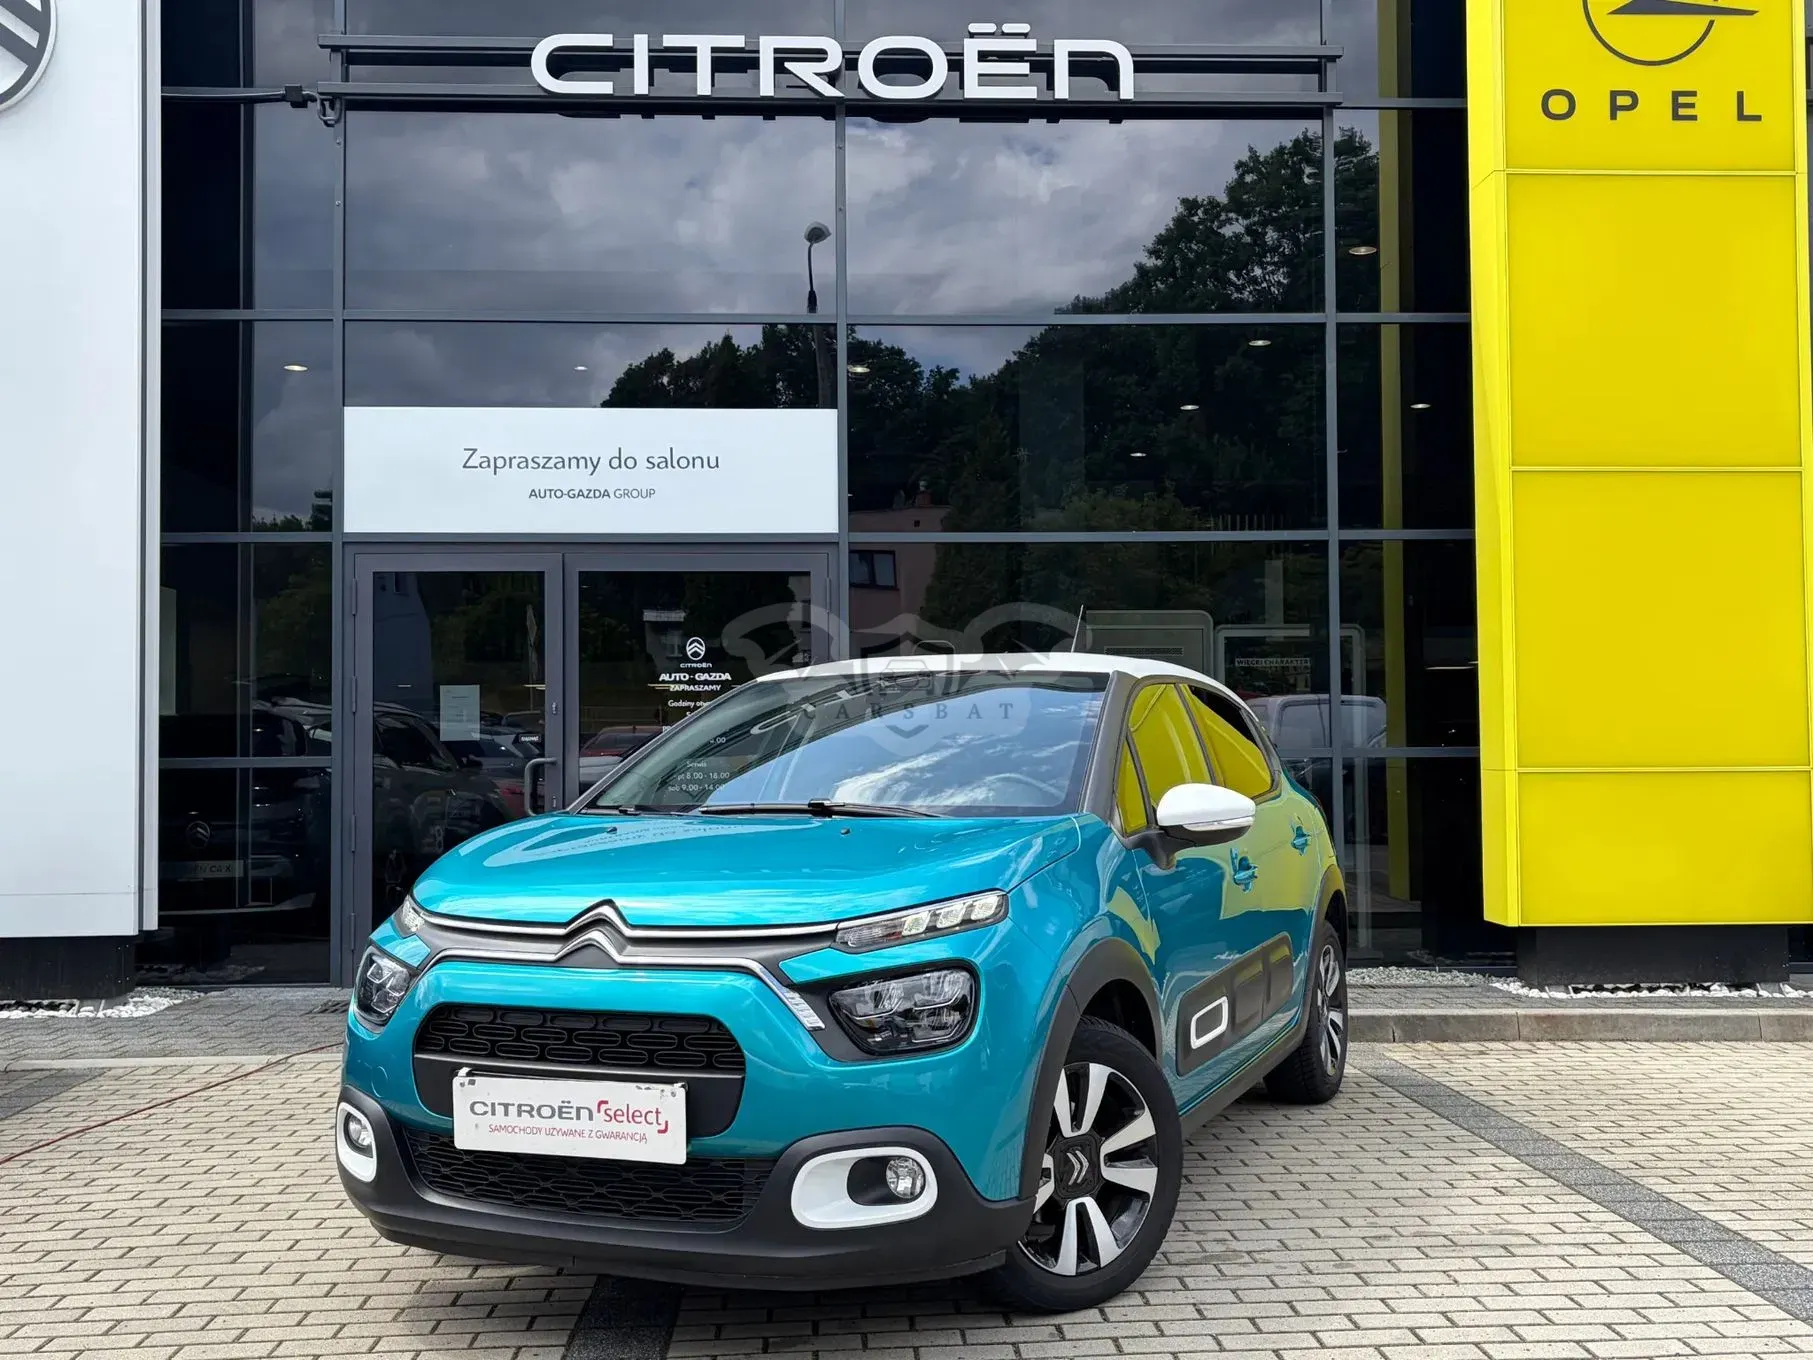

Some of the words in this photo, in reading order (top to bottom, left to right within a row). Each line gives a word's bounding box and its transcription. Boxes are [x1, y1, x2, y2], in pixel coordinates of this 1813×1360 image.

[531, 23, 1134, 100] CITROËN
[1541, 89, 1762, 121] OPEL
[462, 448, 601, 476] Zapraszamy
[608, 447, 638, 470] do
[646, 447, 720, 470] salonu
[528, 488, 611, 499] AUTO-GAZDA
[613, 488, 656, 499] GROUP
[694, 672, 732, 681] GAZDA
[668, 700, 695, 709] Godziny
[469, 1100, 594, 1122] CITROËN
[603, 1103, 662, 1126] select
[488, 1123, 544, 1136] SAMOCHODY
[588, 1129, 595, 1139] Z
